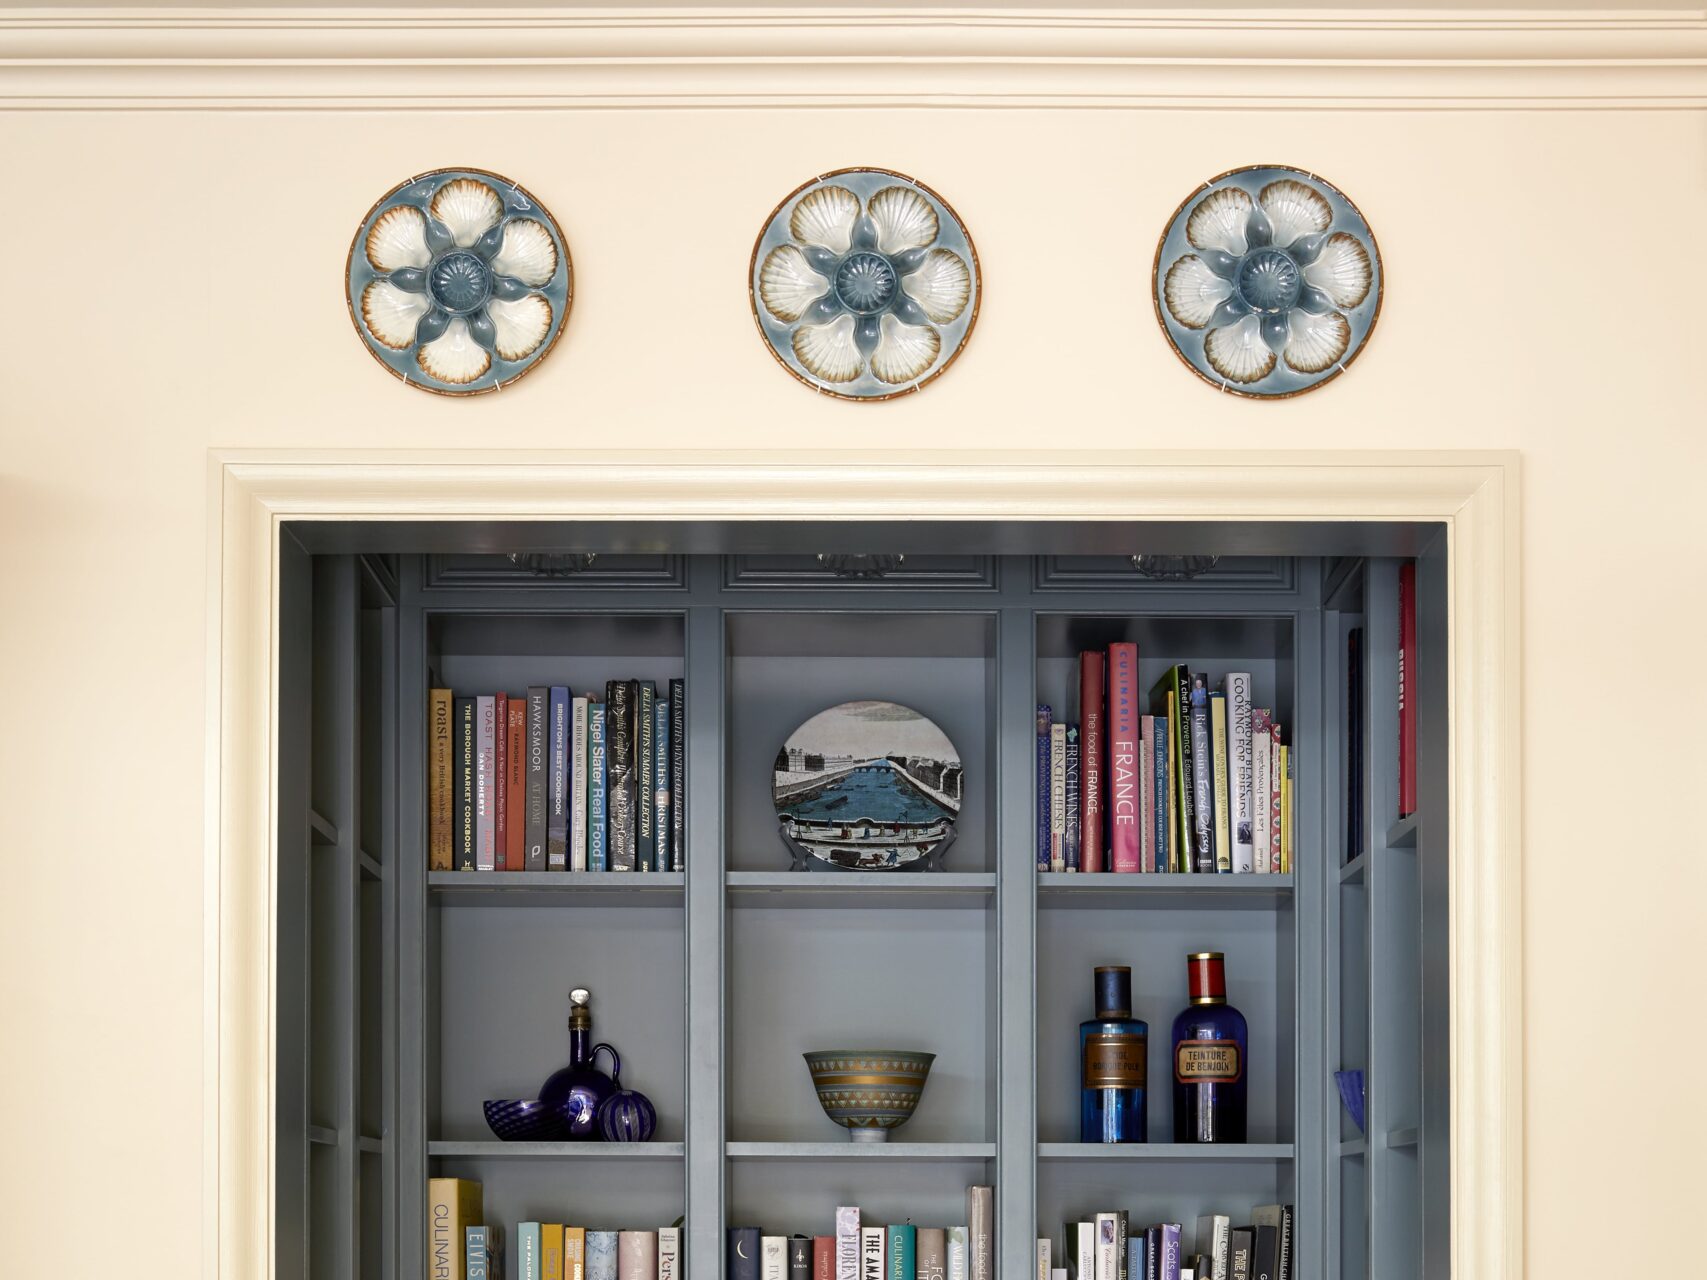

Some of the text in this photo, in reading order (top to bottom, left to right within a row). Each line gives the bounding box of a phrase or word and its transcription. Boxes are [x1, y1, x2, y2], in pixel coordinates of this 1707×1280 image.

[674, 684, 682, 708] DELIA
[437, 701, 449, 740] roast
[1196, 714, 1206, 738] Rick
[614, 731, 626, 763] Complete
[1116, 651, 1132, 825] CULINARIA FRANCE
[1234, 677, 1246, 818] COOKING FOR FRIENDS
[532, 696, 542, 825] HAWKSMOOR AT HOME
[642, 687, 650, 838] DELIA SMITH'S SUMMER COLLECTION
[658, 741, 666, 785] SMITH'S
[674, 745, 682, 777] WINTER
[1054, 740, 1064, 780] FRENCH
[1067, 744, 1078, 789] FRENCH
[1088, 713, 1098, 812] the food of FRANCE
[1182, 705, 1188, 713] in
[1186, 790, 1194, 816] Loubet
[1198, 742, 1208, 776] Stein's
[1256, 750, 1265, 794] Provençales
[438, 765, 446, 789] British
[590, 710, 604, 857] Nigel Slater Real Food
[438, 790, 446, 825] cookbook
[674, 778, 682, 830] COLLECTION
[1054, 785, 1064, 829] CHEESES
[1067, 792, 1078, 828] WINES
[1199, 778, 1209, 810] French
[658, 787, 666, 855] CHRISTMAS
[1200, 812, 1211, 853] Odyssey
[1256, 818, 1264, 832] Les
[616, 830, 626, 855] Course
[1186, 1062, 1229, 1072] DE BENJOIN
[1188, 1051, 1226, 1060] TEINTURE
[866, 1234, 880, 1254] THE
[978, 1233, 988, 1249] the
[1168, 1241, 1178, 1270] Scots
[1220, 1240, 1228, 1271] CARVED
[1282, 1237, 1290, 1267] BRITISH
[820, 1251, 828, 1277] Calabria
[925, 1259, 930, 1268] OF
[952, 1245, 962, 1271] WILD
[978, 1251, 988, 1273] food
[1236, 1249, 1246, 1271] THE
